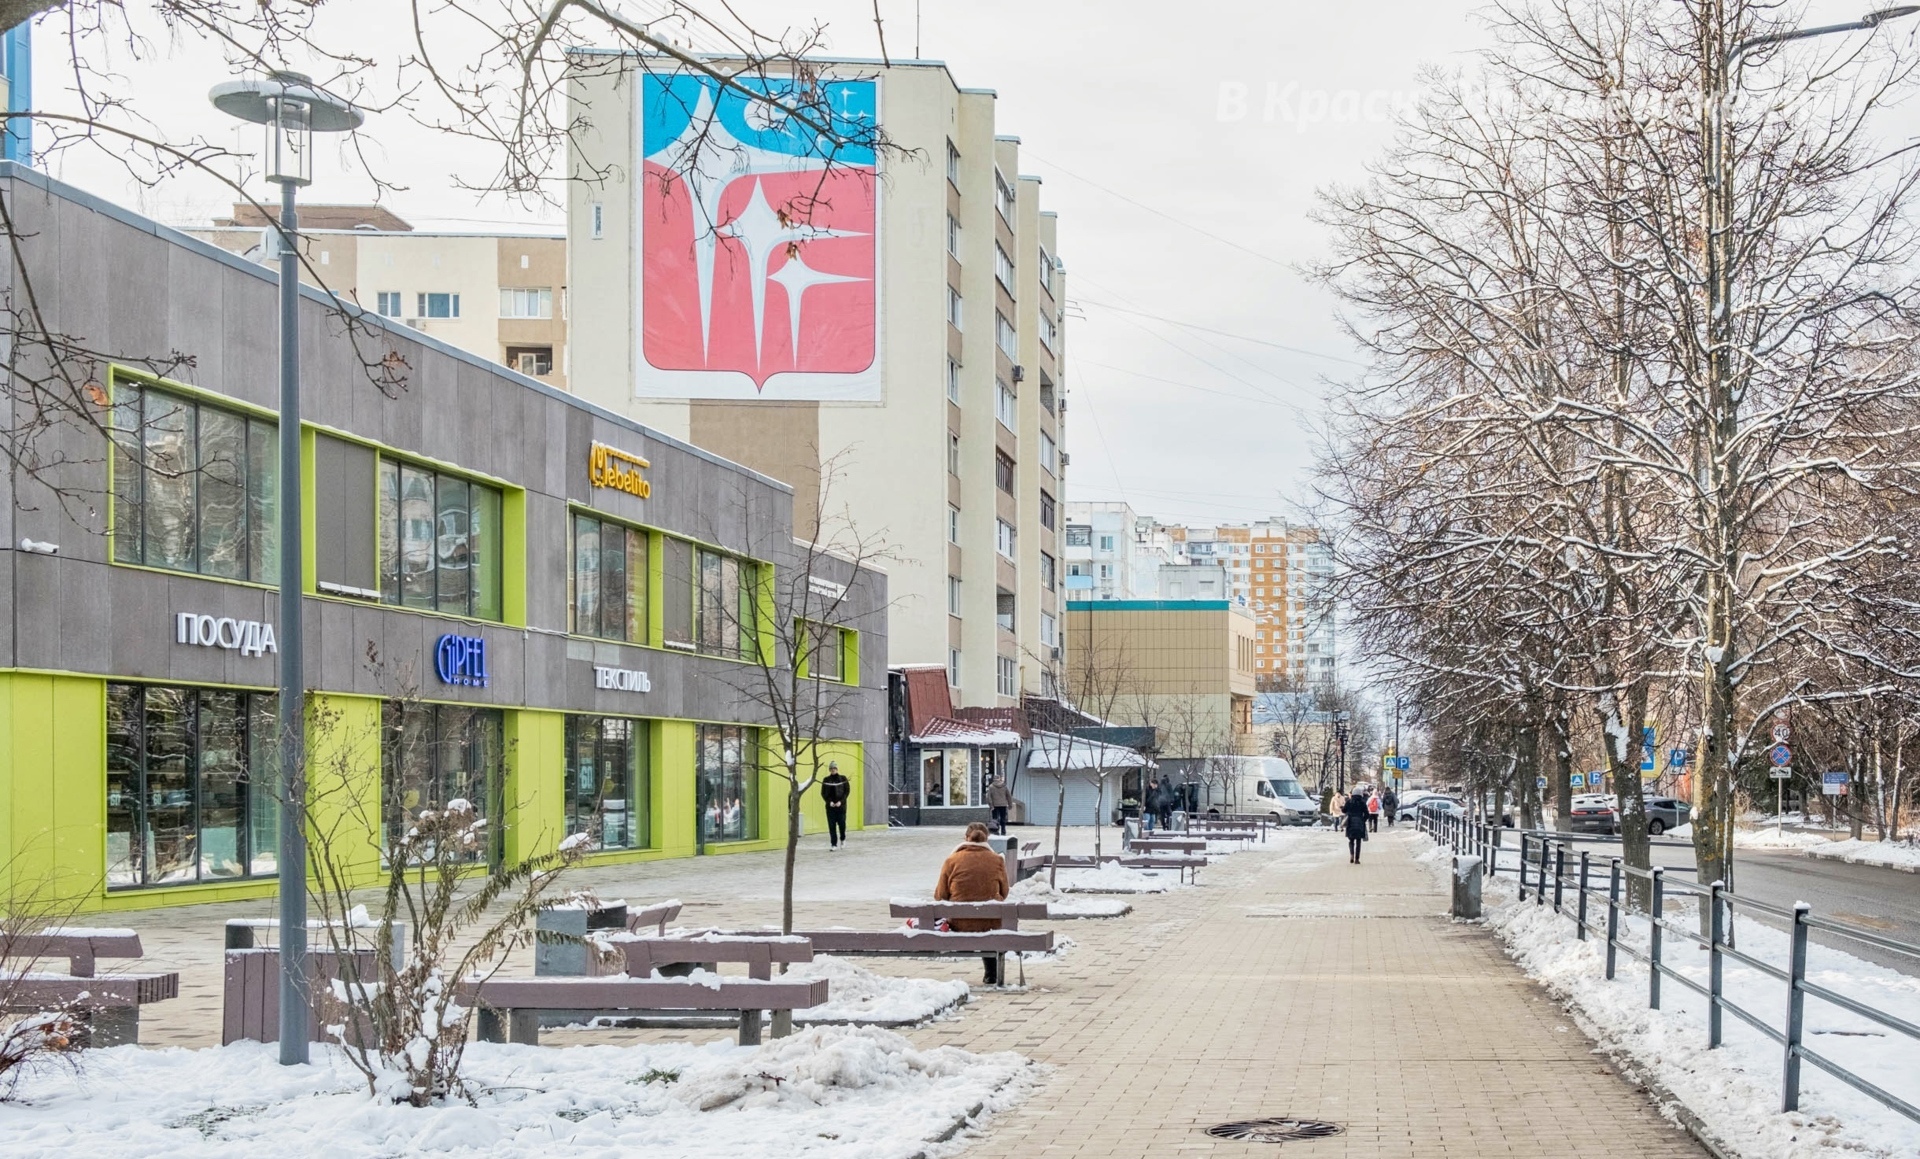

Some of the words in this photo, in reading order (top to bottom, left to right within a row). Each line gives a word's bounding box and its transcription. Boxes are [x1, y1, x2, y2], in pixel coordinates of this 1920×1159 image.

[590, 442, 651, 499] Mebelito
[177, 612, 278, 658] ПОСУДА
[453, 676, 489, 688] HOME
[593, 665, 651, 693] ТЕКСТИЛЬ
[1773, 727, 1789, 738] 40
